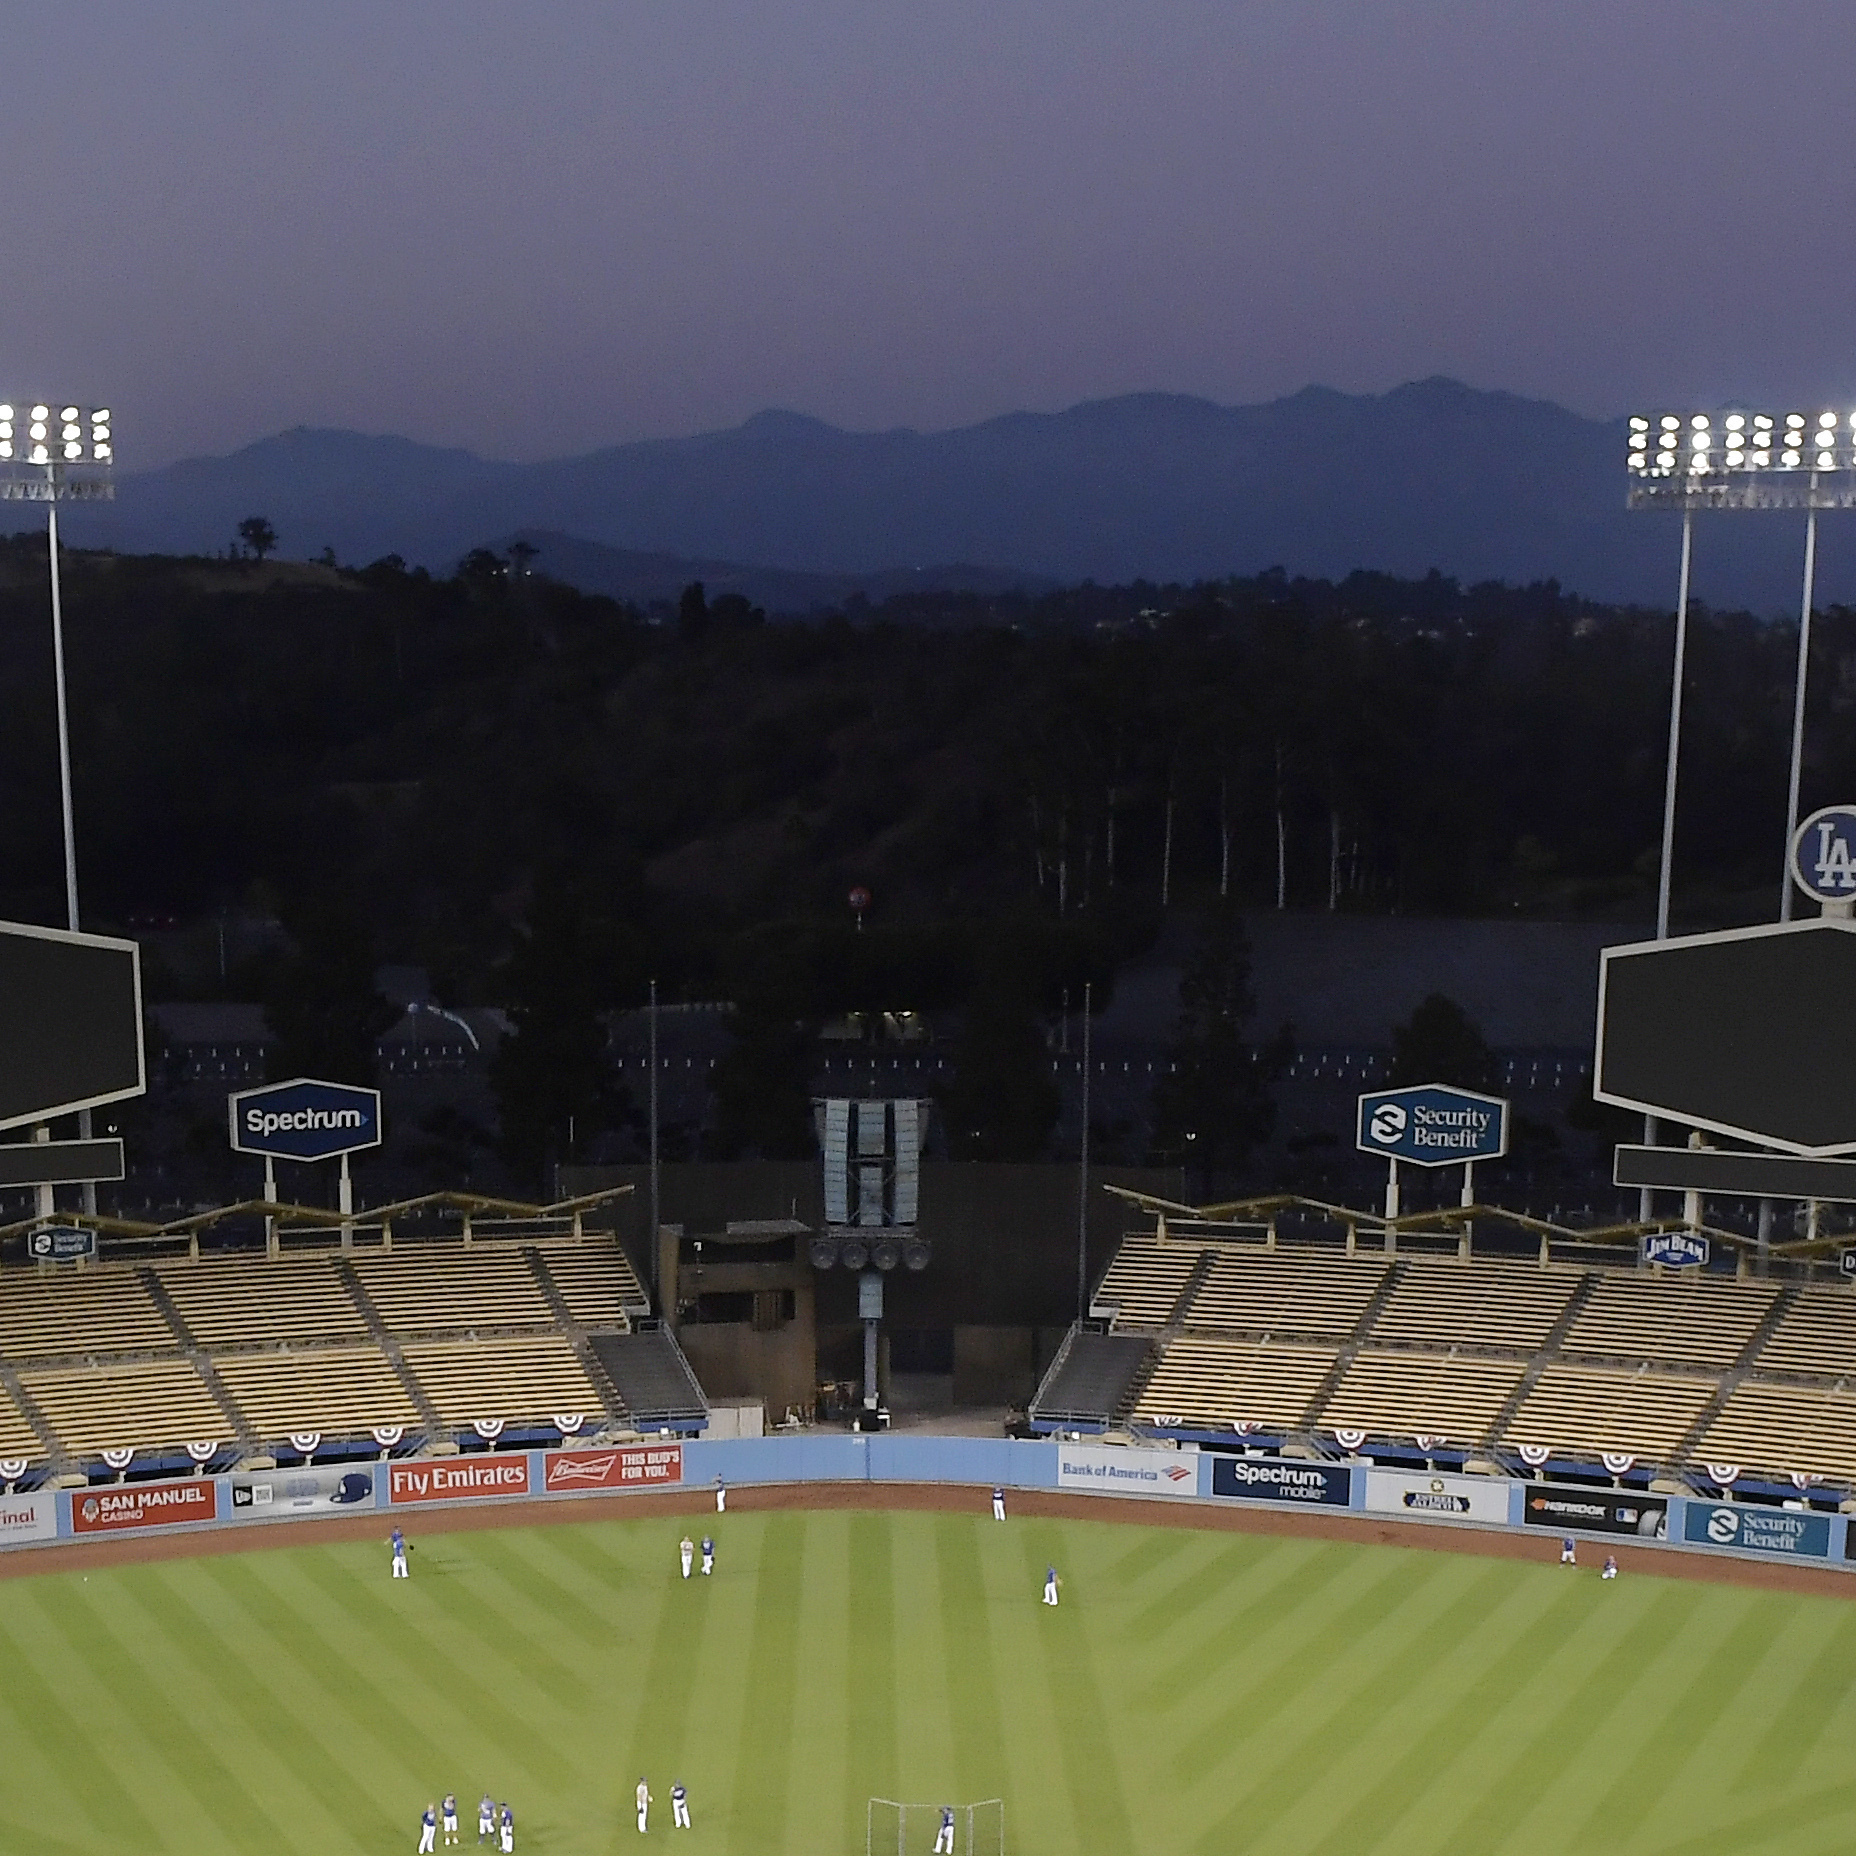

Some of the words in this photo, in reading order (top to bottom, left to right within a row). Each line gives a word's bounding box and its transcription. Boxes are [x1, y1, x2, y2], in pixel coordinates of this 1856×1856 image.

[247, 1107, 361, 1137] Spectrum
[1414, 1105, 1491, 1131] Security
[1414, 1127, 1478, 1148] Benefit
[621, 1452, 646, 1466] THIS
[647, 1450, 680, 1464] BUD'S
[393, 1471, 429, 1495] Fly
[432, 1465, 525, 1489] Emirates
[622, 1465, 644, 1479] FOR
[645, 1464, 670, 1477] YOU.
[1062, 1463, 1093, 1476] Bank
[1094, 1466, 1106, 1476] of
[1109, 1466, 1158, 1481] America
[1235, 1462, 1322, 1486] Spectrum
[100, 1494, 134, 1511] SAN
[137, 1488, 206, 1508] MANUEL
[1279, 1486, 1322, 1500] mobile
[101, 1509, 144, 1523] CASINO
[1744, 1512, 1806, 1537] Security
[1743, 1529, 1794, 1550] Benefit
